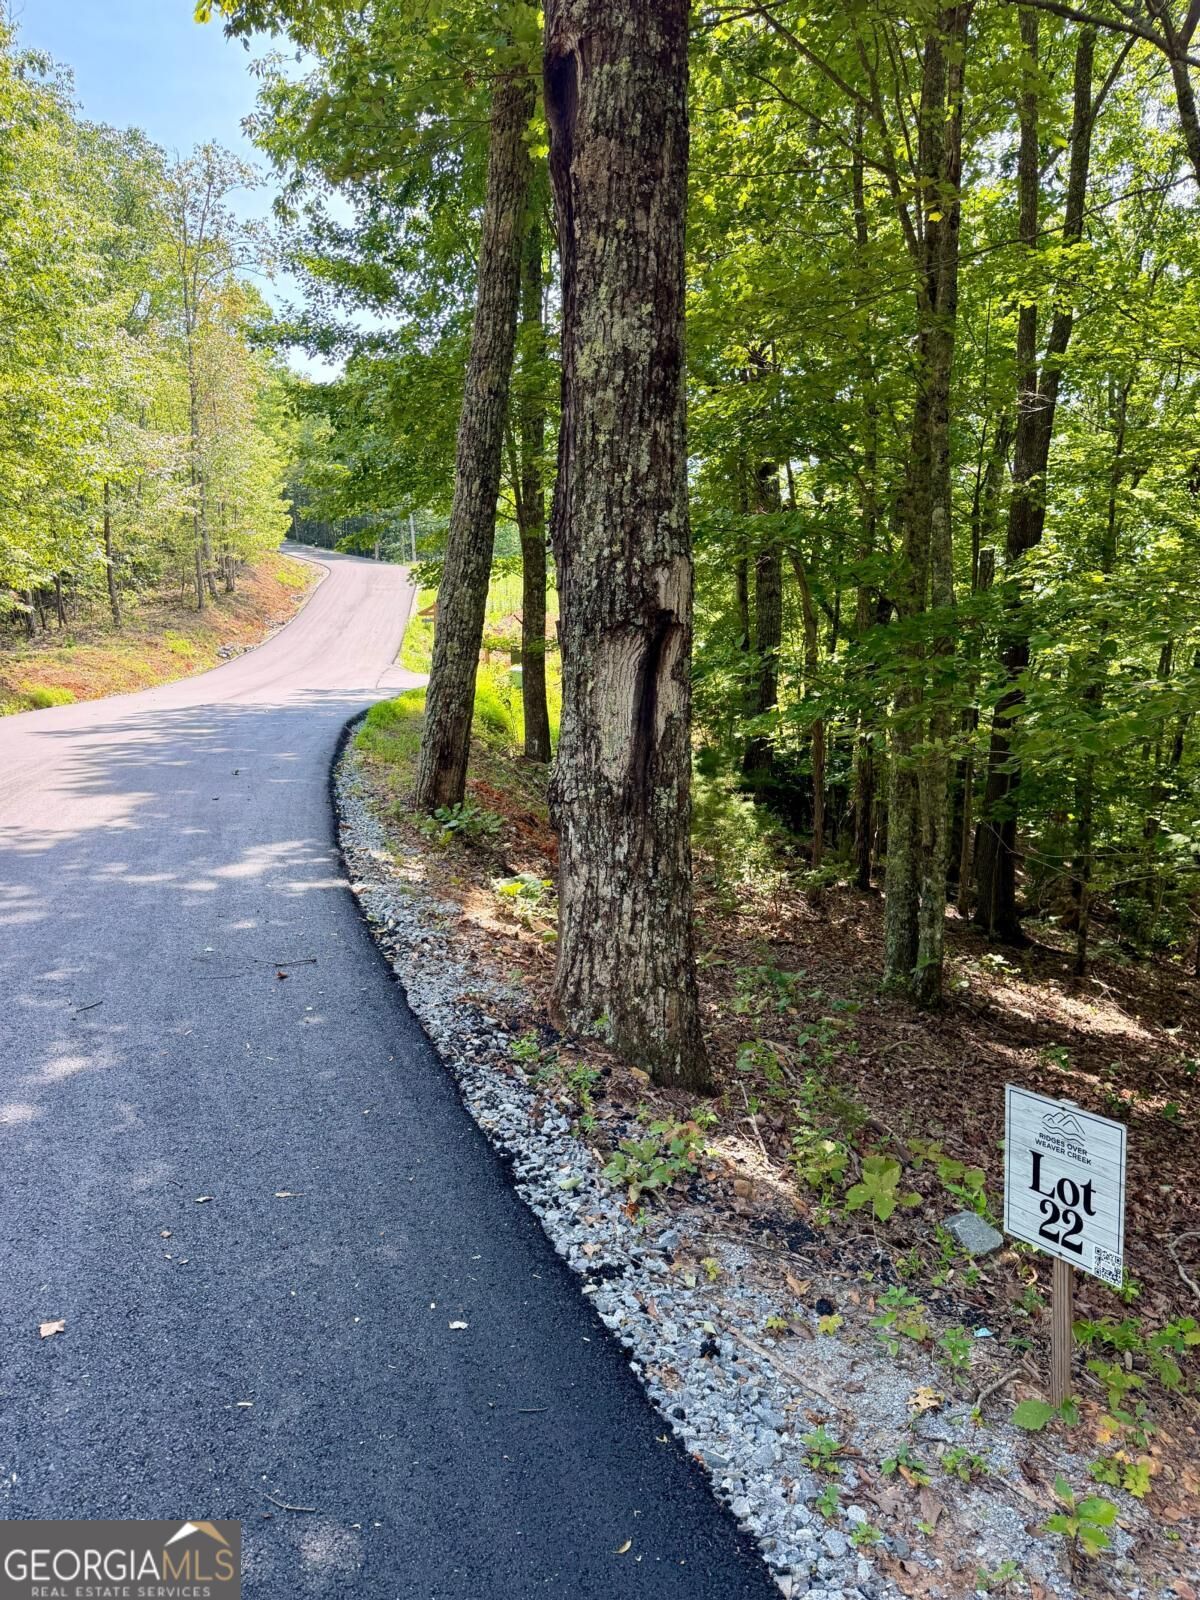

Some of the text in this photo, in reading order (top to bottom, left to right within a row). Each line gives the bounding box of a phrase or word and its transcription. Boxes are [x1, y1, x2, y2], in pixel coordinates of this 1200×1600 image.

[1035, 1138, 1092, 1166] WEAVER CREEK
[1039, 1132, 1088, 1156] RIDGES OVER
[1029, 1150, 1097, 1216] Lot
[1039, 1199, 1084, 1255] 22
